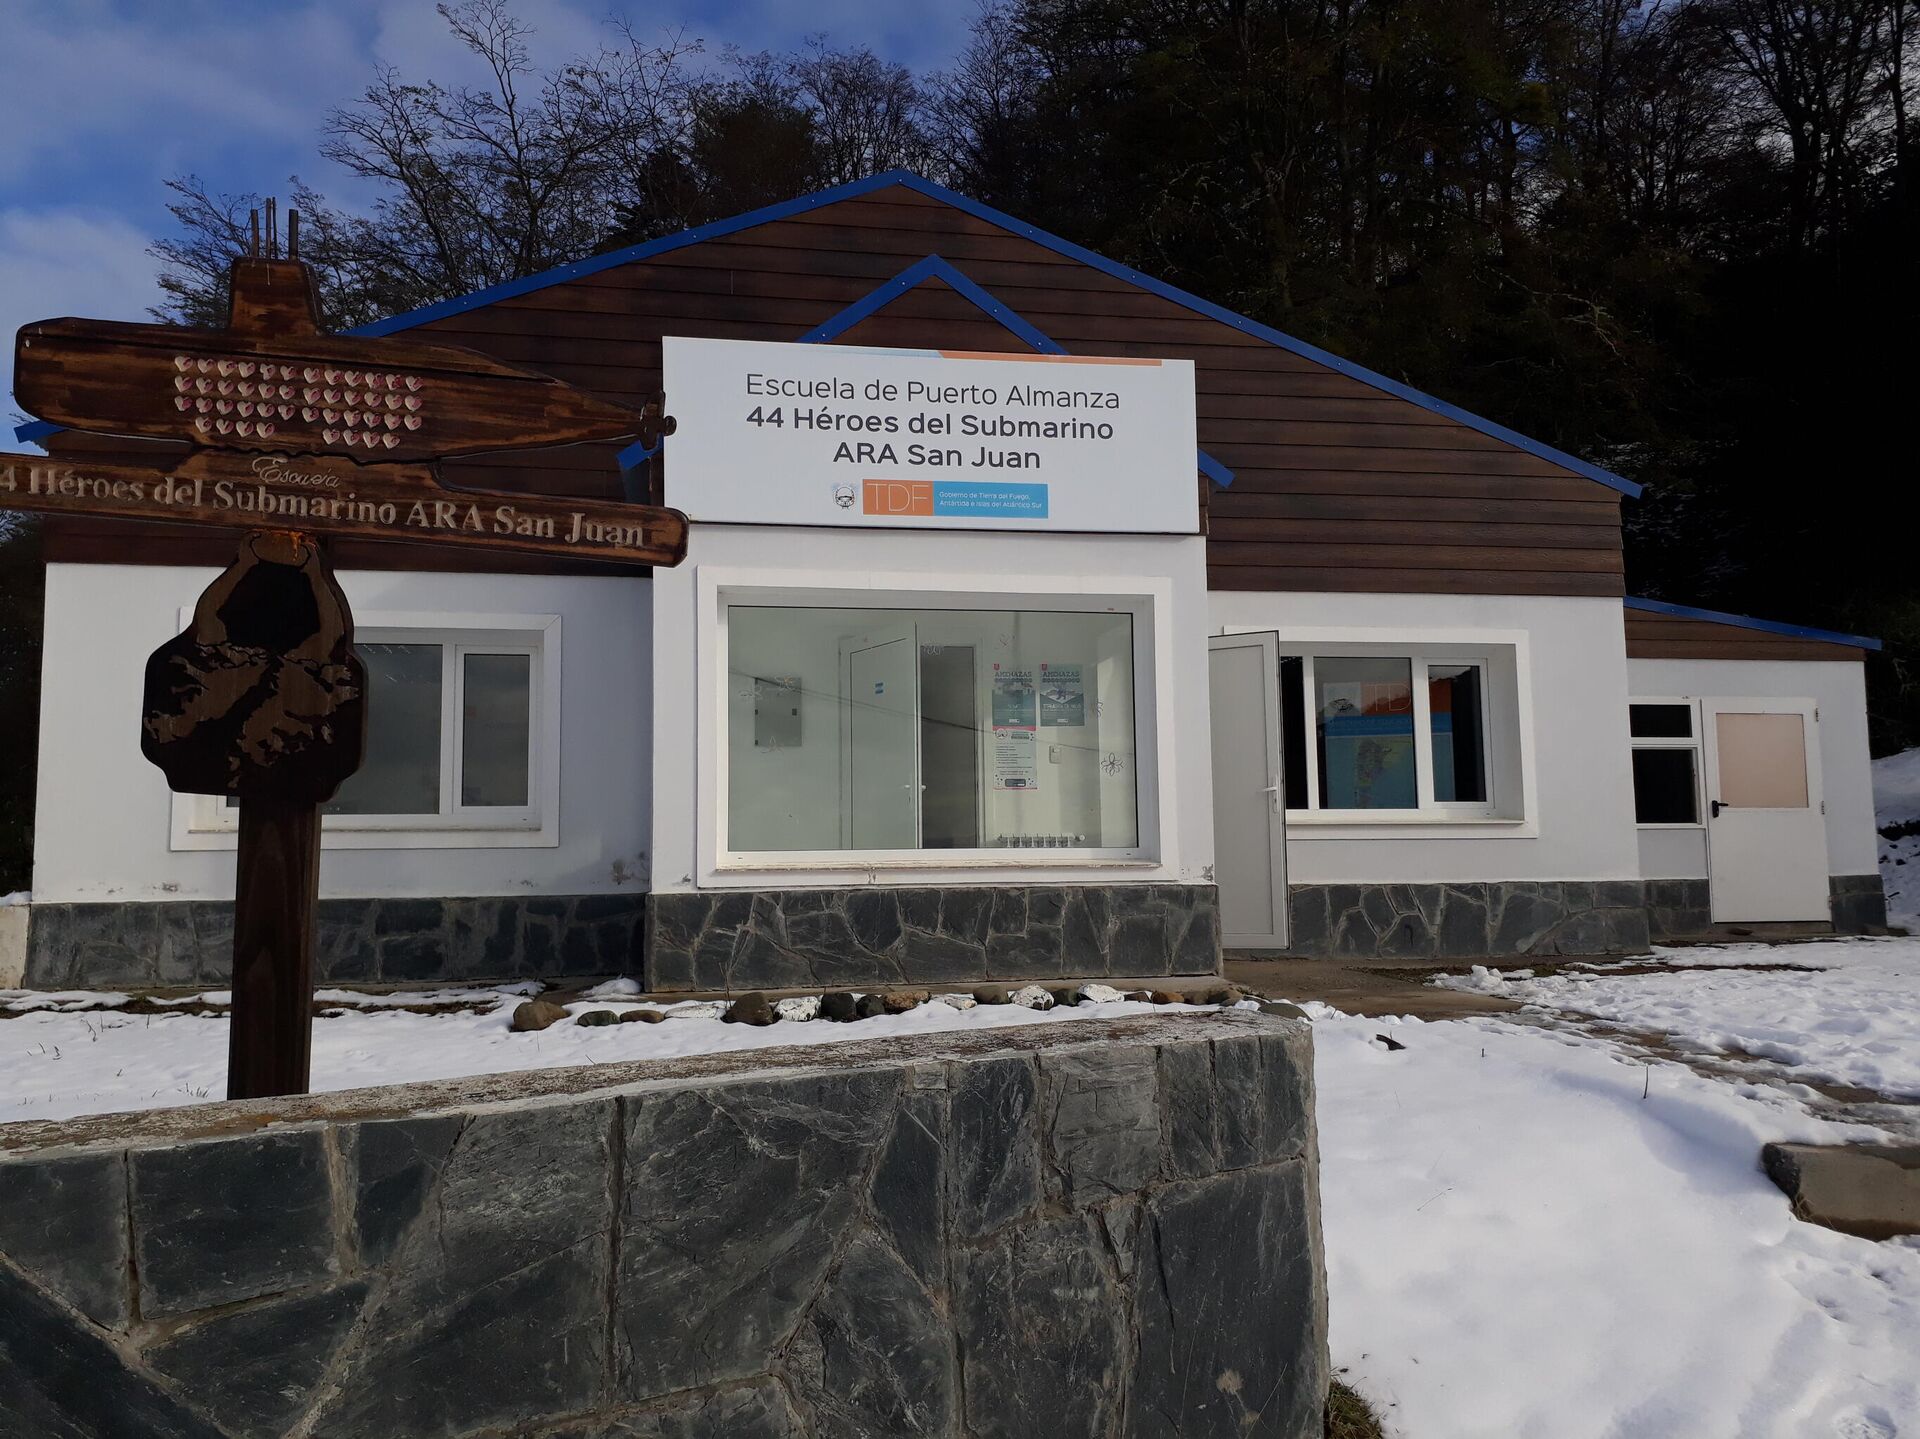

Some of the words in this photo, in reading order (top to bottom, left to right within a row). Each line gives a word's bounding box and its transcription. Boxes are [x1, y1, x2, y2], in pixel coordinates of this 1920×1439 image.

[746, 373, 855, 400] Escuela
[864, 379, 898, 402] de
[908, 381, 997, 405] Puerto
[1006, 385, 1120, 409] Almanza
[746, 406, 785, 428] 44
[794, 406, 899, 433] Héroes
[908, 412, 951, 435] del
[961, 414, 1114, 440] Submarino
[832, 441, 899, 465] ARA
[907, 444, 962, 466] San
[971, 446, 1040, 469] Juan
[252, 456, 342, 488] Escuela
[27, 466, 145, 501] Héroes
[153, 476, 204, 507] del
[213, 480, 397, 525] Submarino
[404, 499, 486, 533] ARA
[493, 505, 555, 539] San
[564, 512, 645, 548] Juan
[866, 483, 929, 513] TDF
